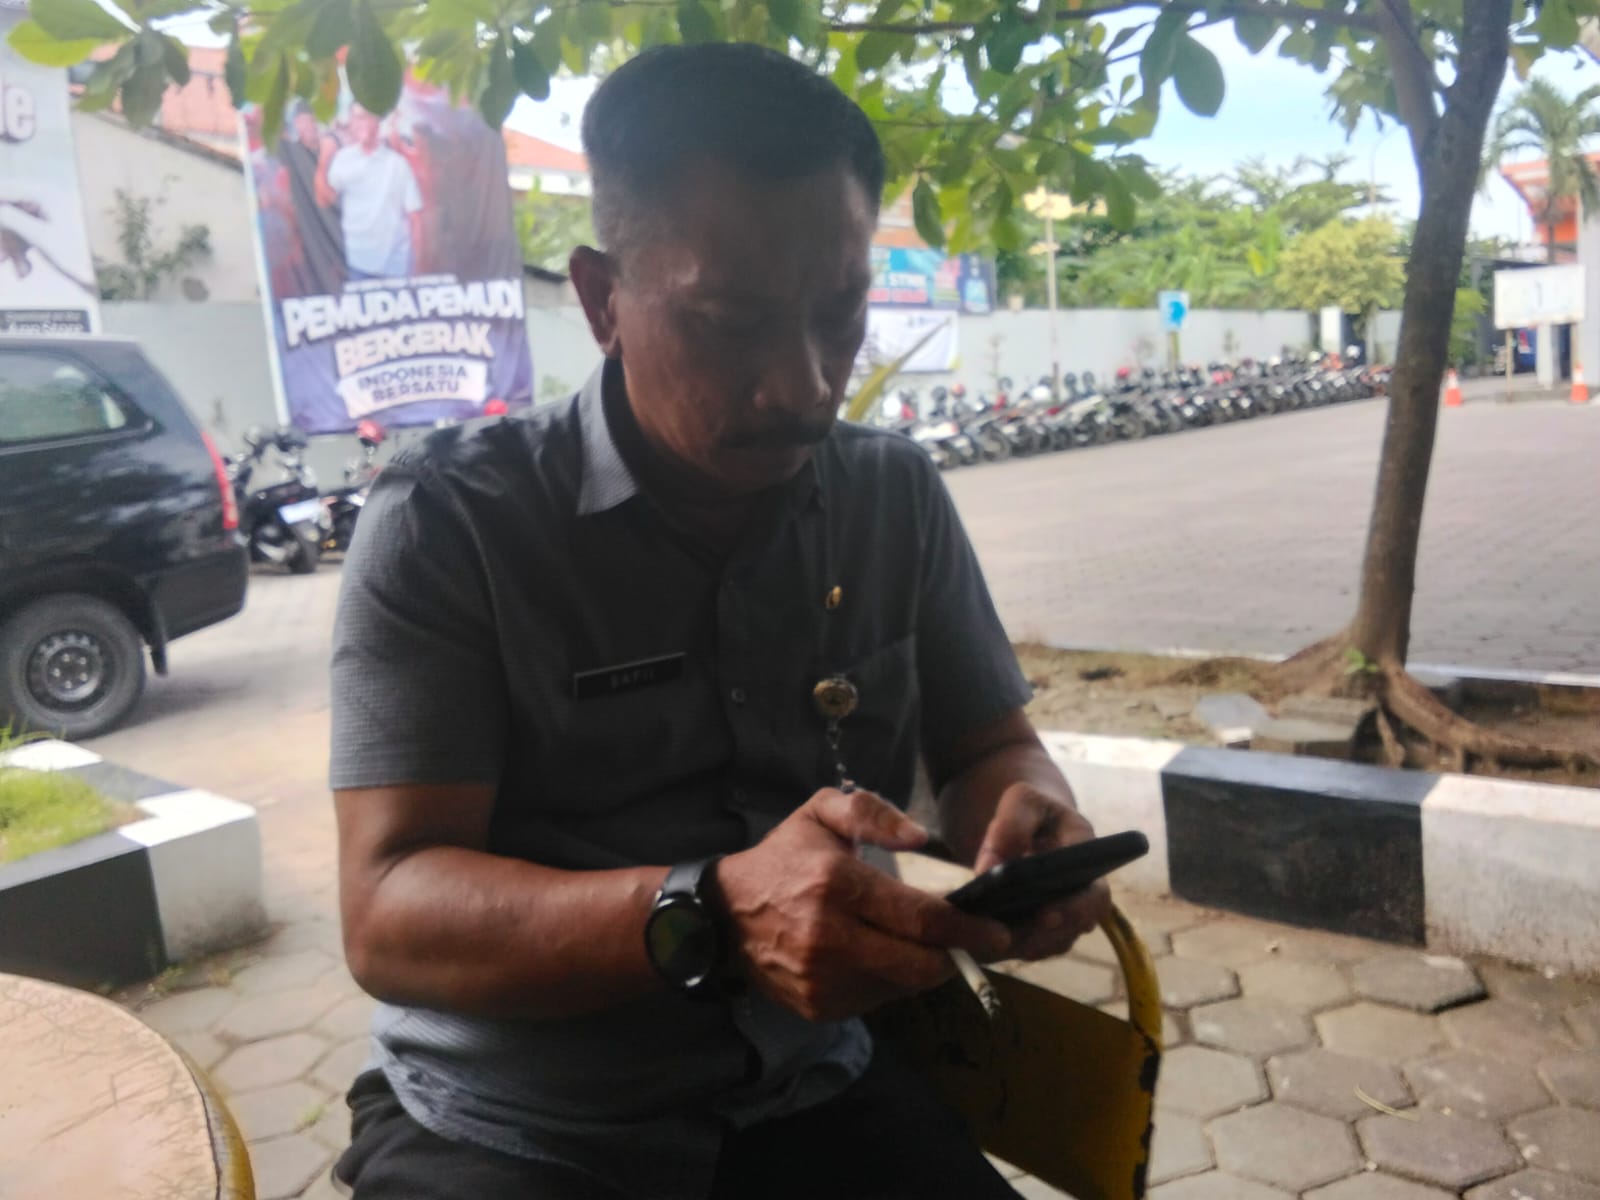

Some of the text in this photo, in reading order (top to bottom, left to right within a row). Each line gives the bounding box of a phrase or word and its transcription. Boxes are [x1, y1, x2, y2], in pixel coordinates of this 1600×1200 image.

[282, 278, 525, 347] PEMUDA PEMUDI
[335, 321, 494, 375] BERGERAK
[357, 364, 468, 391] INDONESIA
[372, 381, 460, 403] BERSATU
